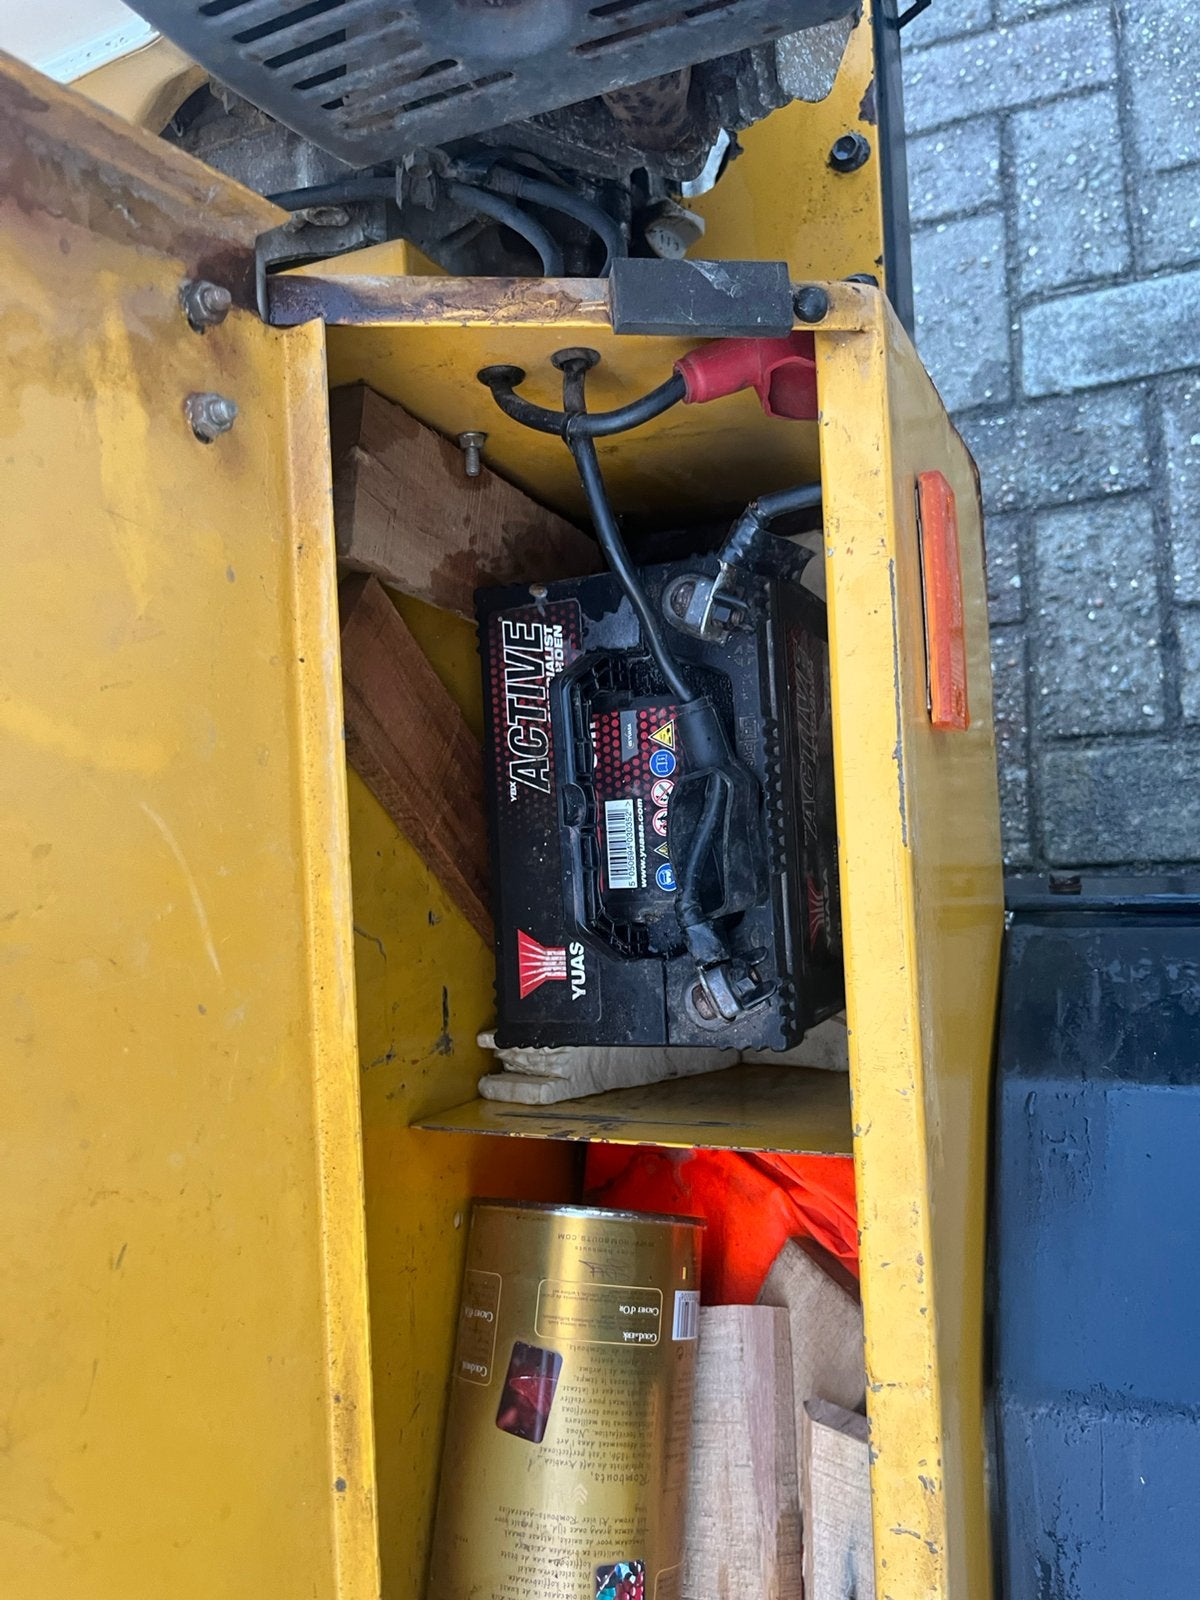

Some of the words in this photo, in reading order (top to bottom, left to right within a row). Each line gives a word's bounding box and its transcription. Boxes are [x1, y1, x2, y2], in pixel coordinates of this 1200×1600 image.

[502, 621, 551, 793] ACTIVE
[625, 811, 633, 842] 030352
[637, 799, 647, 887] www.yuasa.com
[627, 845, 635, 877] 050694
[569, 942, 586, 1000] YUAS
[545, 1458, 577, 1469] Arabica
[590, 1471, 648, 1486] Rombouts,
